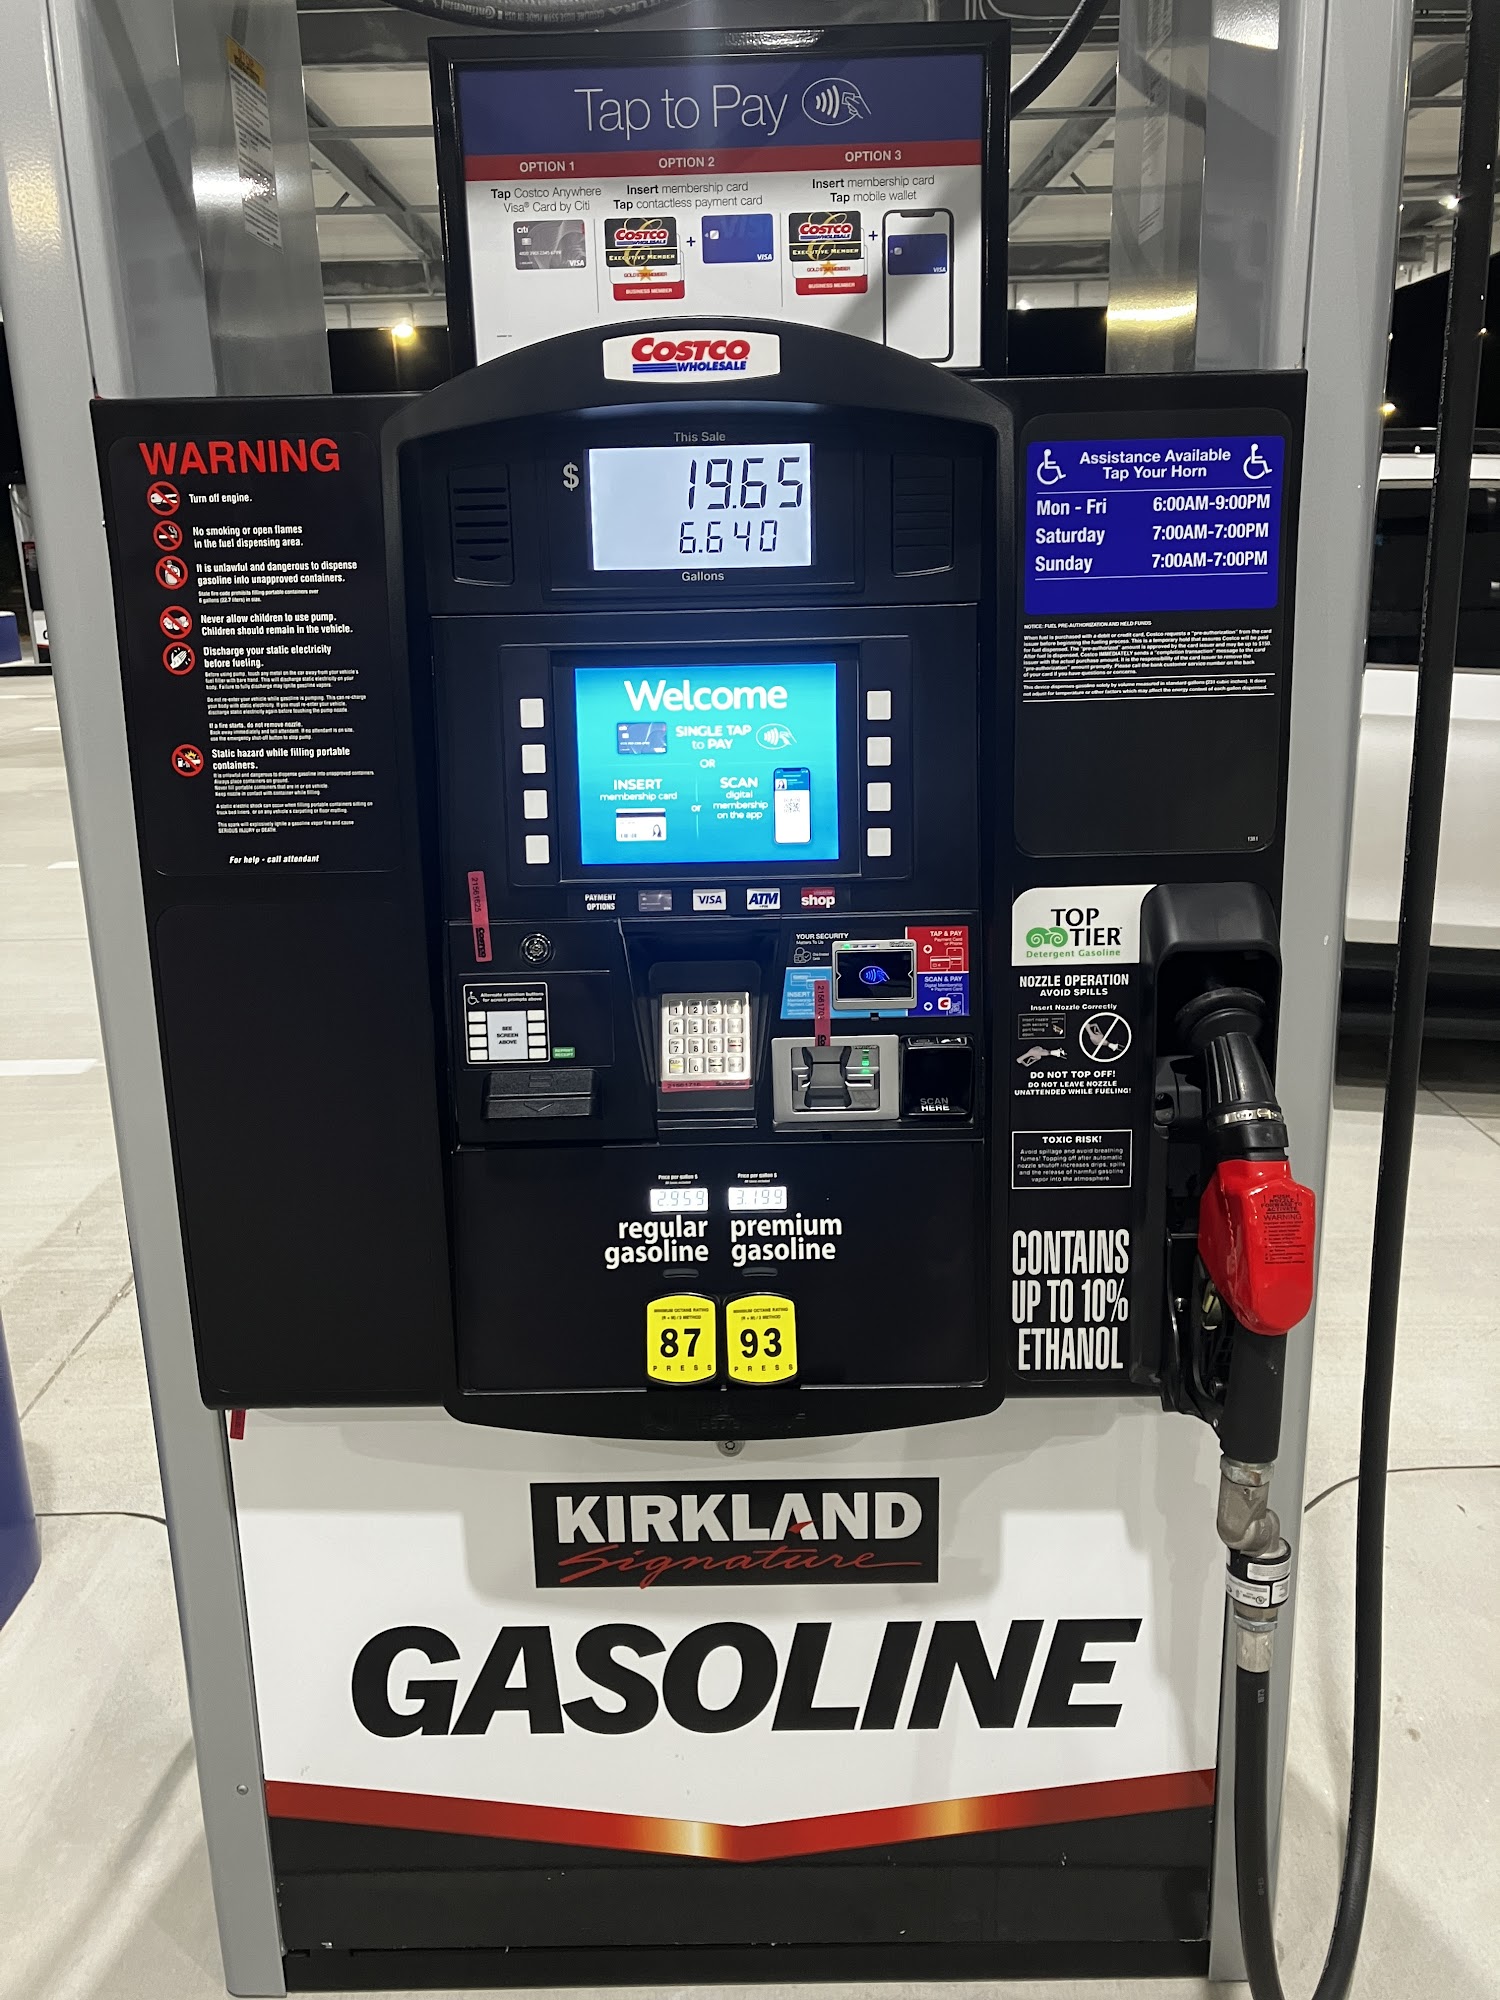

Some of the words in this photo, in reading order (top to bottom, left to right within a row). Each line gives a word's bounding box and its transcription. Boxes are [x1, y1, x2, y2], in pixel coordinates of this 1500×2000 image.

[574, 88, 650, 140] Tap
[661, 88, 700, 129] to
[713, 84, 788, 136] Pay
[658, 156, 704, 168] OPTION
[708, 156, 714, 166] 2
[845, 150, 890, 162] OPTION
[895, 150, 901, 160] 3
[520, 161, 565, 172] OPTION
[569, 161, 573, 170] 1
[626, 184, 659, 196] Insert
[659, 182, 725, 195] membership
[725, 181, 748, 193] card
[812, 177, 846, 189] Insert
[846, 175, 910, 188] membership
[912, 175, 934, 186] card
[491, 188, 513, 200] Tap
[513, 187, 551, 199] Costco
[551, 186, 602, 199] Anywhere
[830, 192, 849, 204] Tap
[853, 191, 885, 202] mobile
[889, 190, 916, 200] wallet
[532, 201, 557, 212] Card
[558, 201, 573, 211] by
[573, 200, 589, 211] Citi
[613, 199, 634, 211] Tap
[636, 197, 694, 210] contactless
[694, 196, 737, 209] payment
[740, 195, 763, 206] card
[615, 228, 668, 241] COSTCO
[799, 224, 853, 235] COSTCO
[569, 259, 585, 267] VISA
[632, 337, 750, 360] COSTCO
[676, 358, 746, 372] WHOLESALE
[674, 432, 698, 442] This
[701, 432, 726, 442] Sale
[139, 438, 340, 475] WARNING
[1079, 449, 1160, 464] Assistance
[1164, 448, 1230, 462] Available
[562, 462, 580, 492] $
[1102, 466, 1128, 481] Tap
[1133, 465, 1167, 478] Your
[1171, 464, 1206, 477] Horn
[688, 456, 803, 510] 19.65
[188, 493, 206, 503] Turn
[208, 493, 219, 502] off
[221, 492, 252, 503] engine.
[1037, 499, 1069, 515] Mon
[1086, 498, 1106, 514] Fri
[1153, 494, 1270, 512] 6:00AM-9:00PM
[192, 526, 204, 535] No
[206, 526, 240, 537] smoking
[252, 526, 272, 536] open
[274, 525, 302, 533] flames
[679, 519, 778, 554] 6.640
[1036, 528, 1106, 546] Saturday
[1152, 522, 1269, 540] 7:00AM-7:00PM
[194, 539, 202, 548] in
[204, 539, 216, 548] the
[218, 539, 234, 547] fuel
[236, 538, 280, 548] dispensing
[282, 538, 303, 546] area.
[196, 563, 202, 572] It
[204, 563, 211, 572] is
[213, 562, 247, 572] unlawful
[250, 562, 264, 571] and
[267, 561, 309, 572] dangerous
[310, 561, 318, 570] to
[321, 560, 357, 571] dispense
[1036, 556, 1093, 573] Sunday
[1152, 551, 1268, 568] 7:00AM-7:00PM
[681, 572, 725, 582] Gallons
[200, 614, 224, 623] Never
[226, 613, 248, 623] allow
[250, 613, 282, 622] children
[284, 613, 292, 621] to
[311, 613, 336, 623] pump.
[203, 646, 244, 657] Discharge
[246, 647, 264, 656] your
[266, 646, 288, 654] static
[290, 645, 331, 655] electricity
[204, 658, 230, 667] before
[232, 658, 263, 668] fueling.
[624, 680, 788, 712] Welcome
[676, 725, 722, 738] SINGLE
[726, 724, 752, 737] TAP
[691, 740, 705, 750] to
[707, 739, 734, 750] PAY
[700, 758, 716, 769] OR
[613, 778, 662, 791] INSERT
[720, 776, 758, 788] SCAN
[600, 792, 656, 802] membership
[658, 791, 678, 801] card
[725, 790, 753, 800] digital
[712, 800, 768, 810] membership
[716, 811, 728, 820] on
[729, 810, 745, 820] the
[746, 811, 763, 821] app
[243, 855, 259, 864] help
[266, 855, 281, 863] call
[283, 854, 318, 862] attendant
[584, 892, 616, 902] PAYMENT
[697, 894, 723, 906] VISA
[748, 892, 780, 906] ATM
[801, 894, 836, 908] shop
[586, 902, 616, 911] OPTIONS
[1050, 908, 1100, 926] TOP
[816, 932, 849, 940] SECURITY
[1069, 927, 1122, 946] TIER
[1026, 950, 1074, 959] Detergent
[1019, 975, 1060, 987] NOZZLE
[1064, 974, 1128, 986] OPERATION
[1039, 988, 1070, 996] AVOID
[1070, 1070, 1090, 1078] TOP
[920, 1097, 949, 1106] SCAN
[921, 1104, 950, 1112] HERE
[1075, 1135, 1101, 1143] RISK!
[656, 1190, 706, 1207] 2.959
[736, 1188, 784, 1206] 3.199
[618, 1214, 708, 1244] regular
[730, 1212, 842, 1242] premium
[604, 1238, 709, 1270] gasoline
[731, 1237, 836, 1267] gasoline
[1012, 1228, 1130, 1276] CONTAINS
[1012, 1280, 1042, 1324] UP
[1046, 1278, 1074, 1323] TO
[1081, 1278, 1129, 1322] 10%
[660, 1328, 702, 1358] 87
[740, 1327, 782, 1358] 93
[1018, 1326, 1124, 1370] ETHANOL
[556, 1492, 922, 1544] KIRKLAND
[557, 1544, 922, 1590] Signature
[351, 1618, 1141, 1737] GASOLINE
